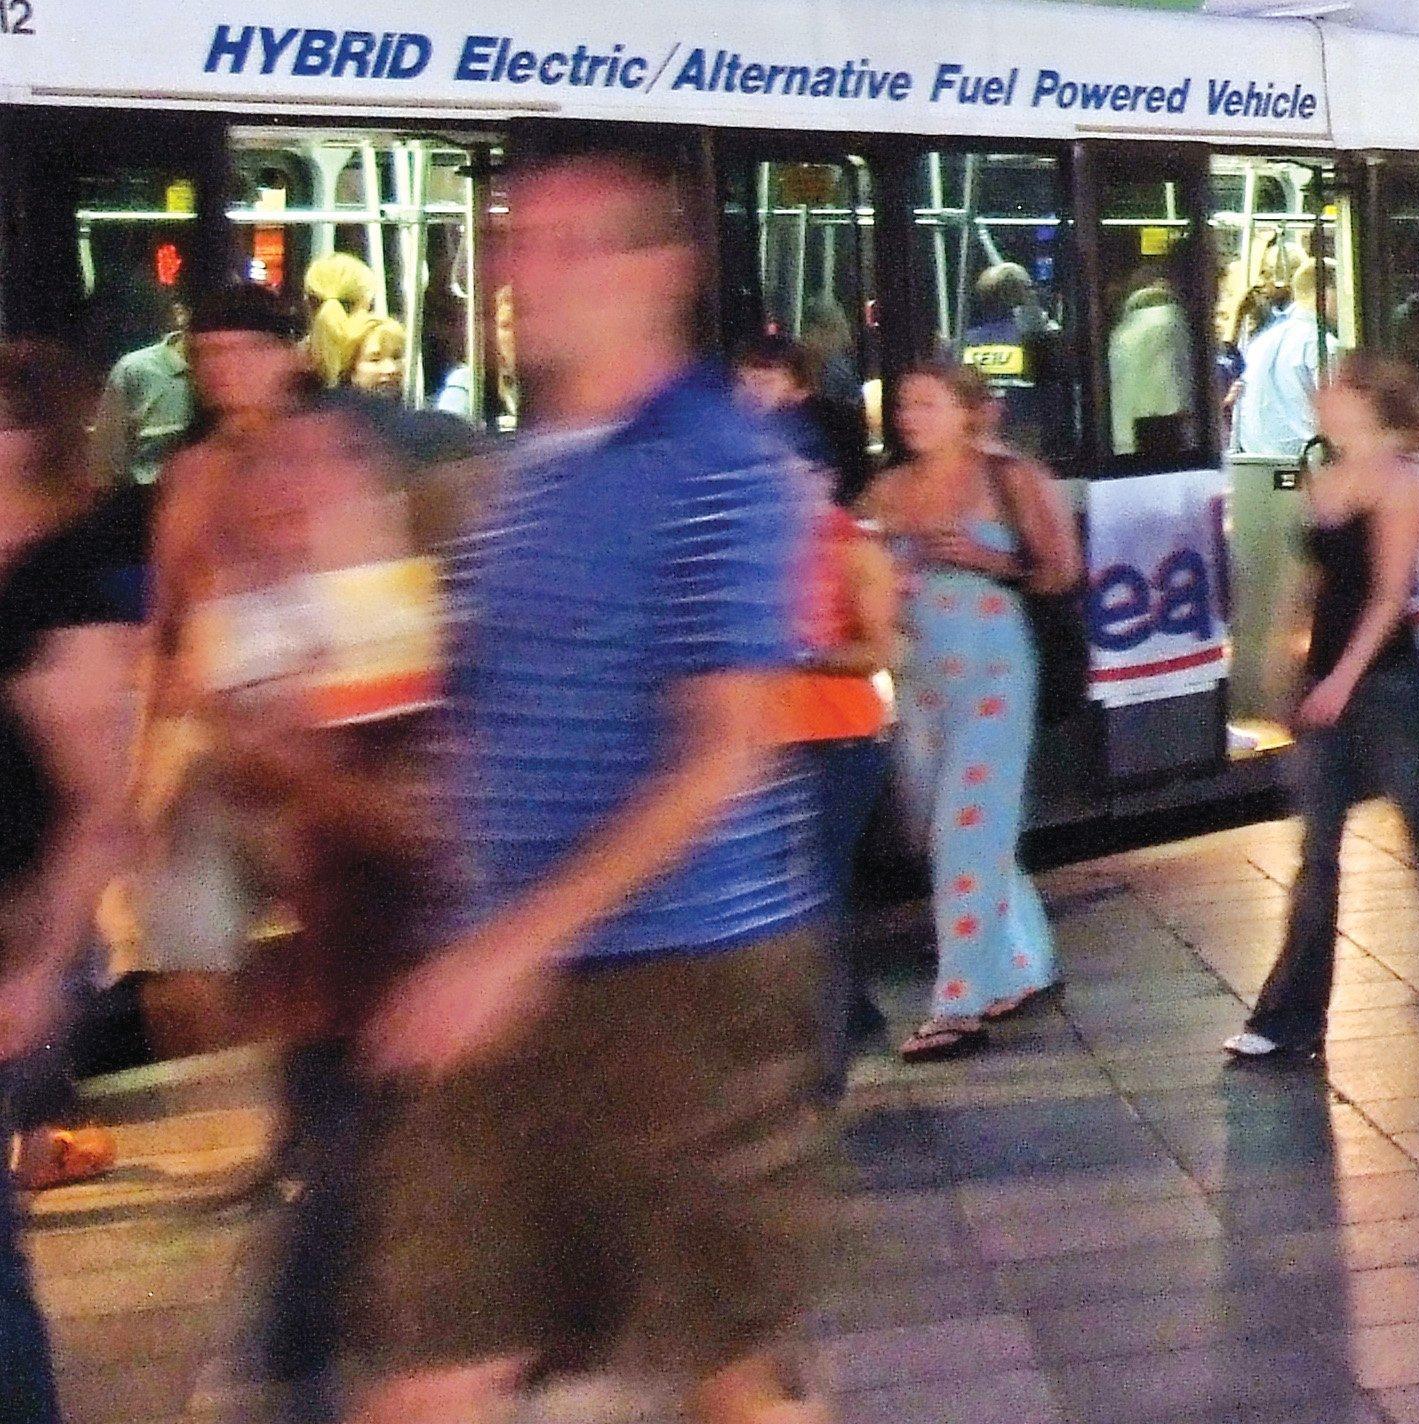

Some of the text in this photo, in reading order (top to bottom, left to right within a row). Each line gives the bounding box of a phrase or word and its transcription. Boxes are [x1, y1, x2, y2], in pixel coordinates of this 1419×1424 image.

[203, 24, 433, 80] HYBRID
[929, 62, 1020, 107] Fuel
[1031, 69, 1191, 115] Powered
[1206, 78, 1318, 121] Vehicle
